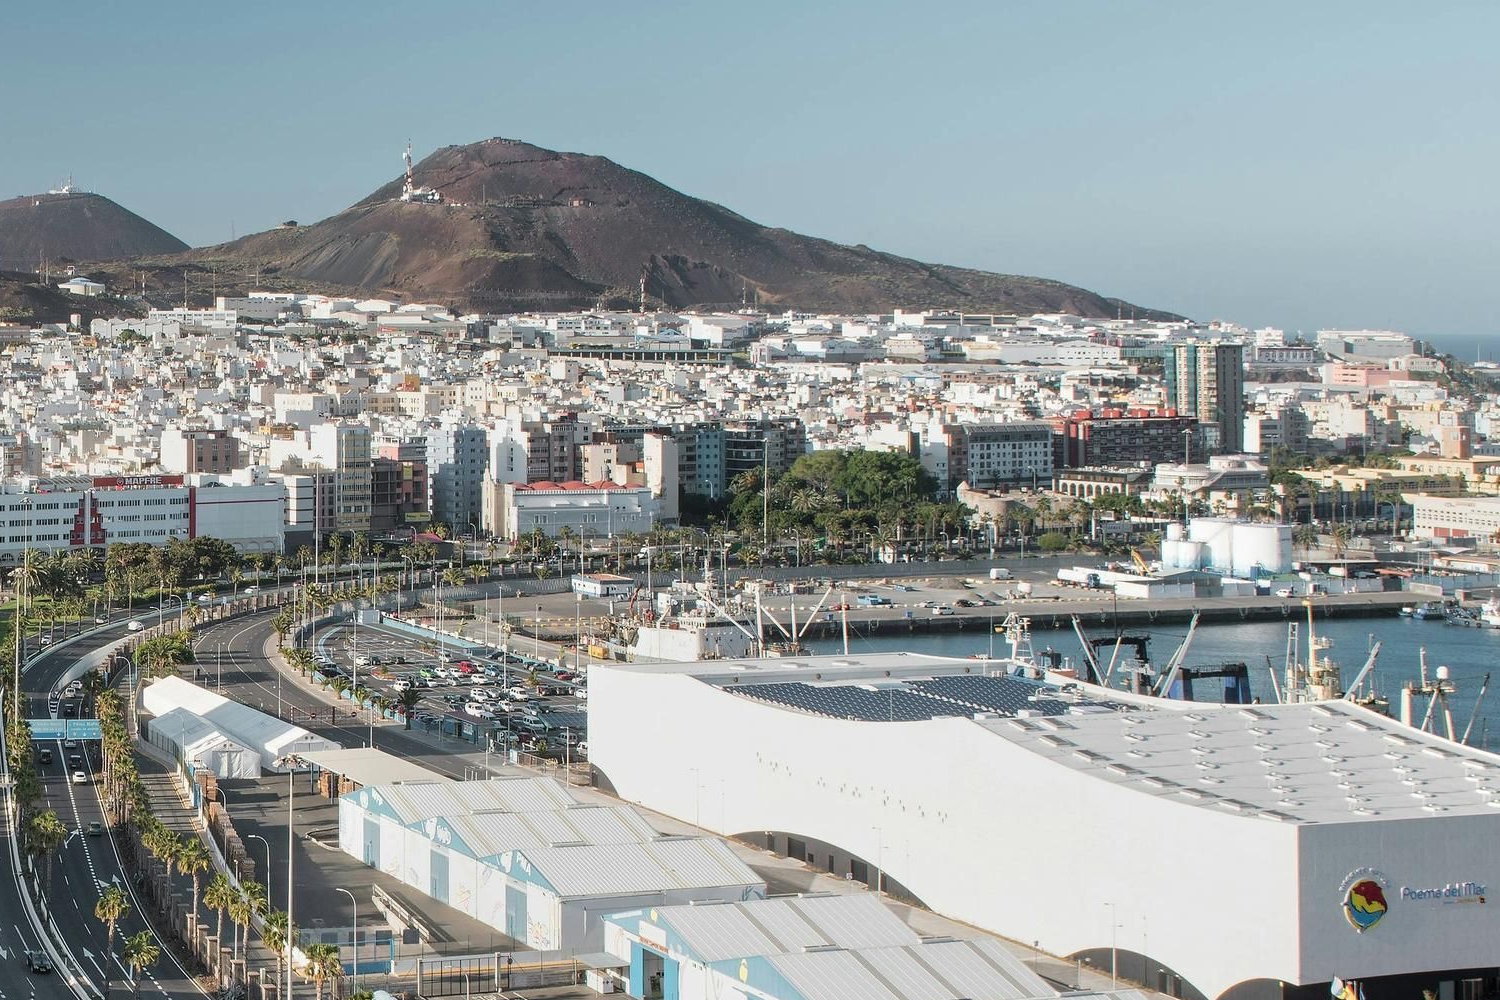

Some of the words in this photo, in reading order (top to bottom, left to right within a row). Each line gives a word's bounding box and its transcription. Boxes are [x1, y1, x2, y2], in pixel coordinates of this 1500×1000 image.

[125, 476, 162, 485] MAPFRE
[1400, 886, 1442, 900] Poema
[1442, 882, 1460, 897] del
[1462, 881, 1487, 896] Mar
